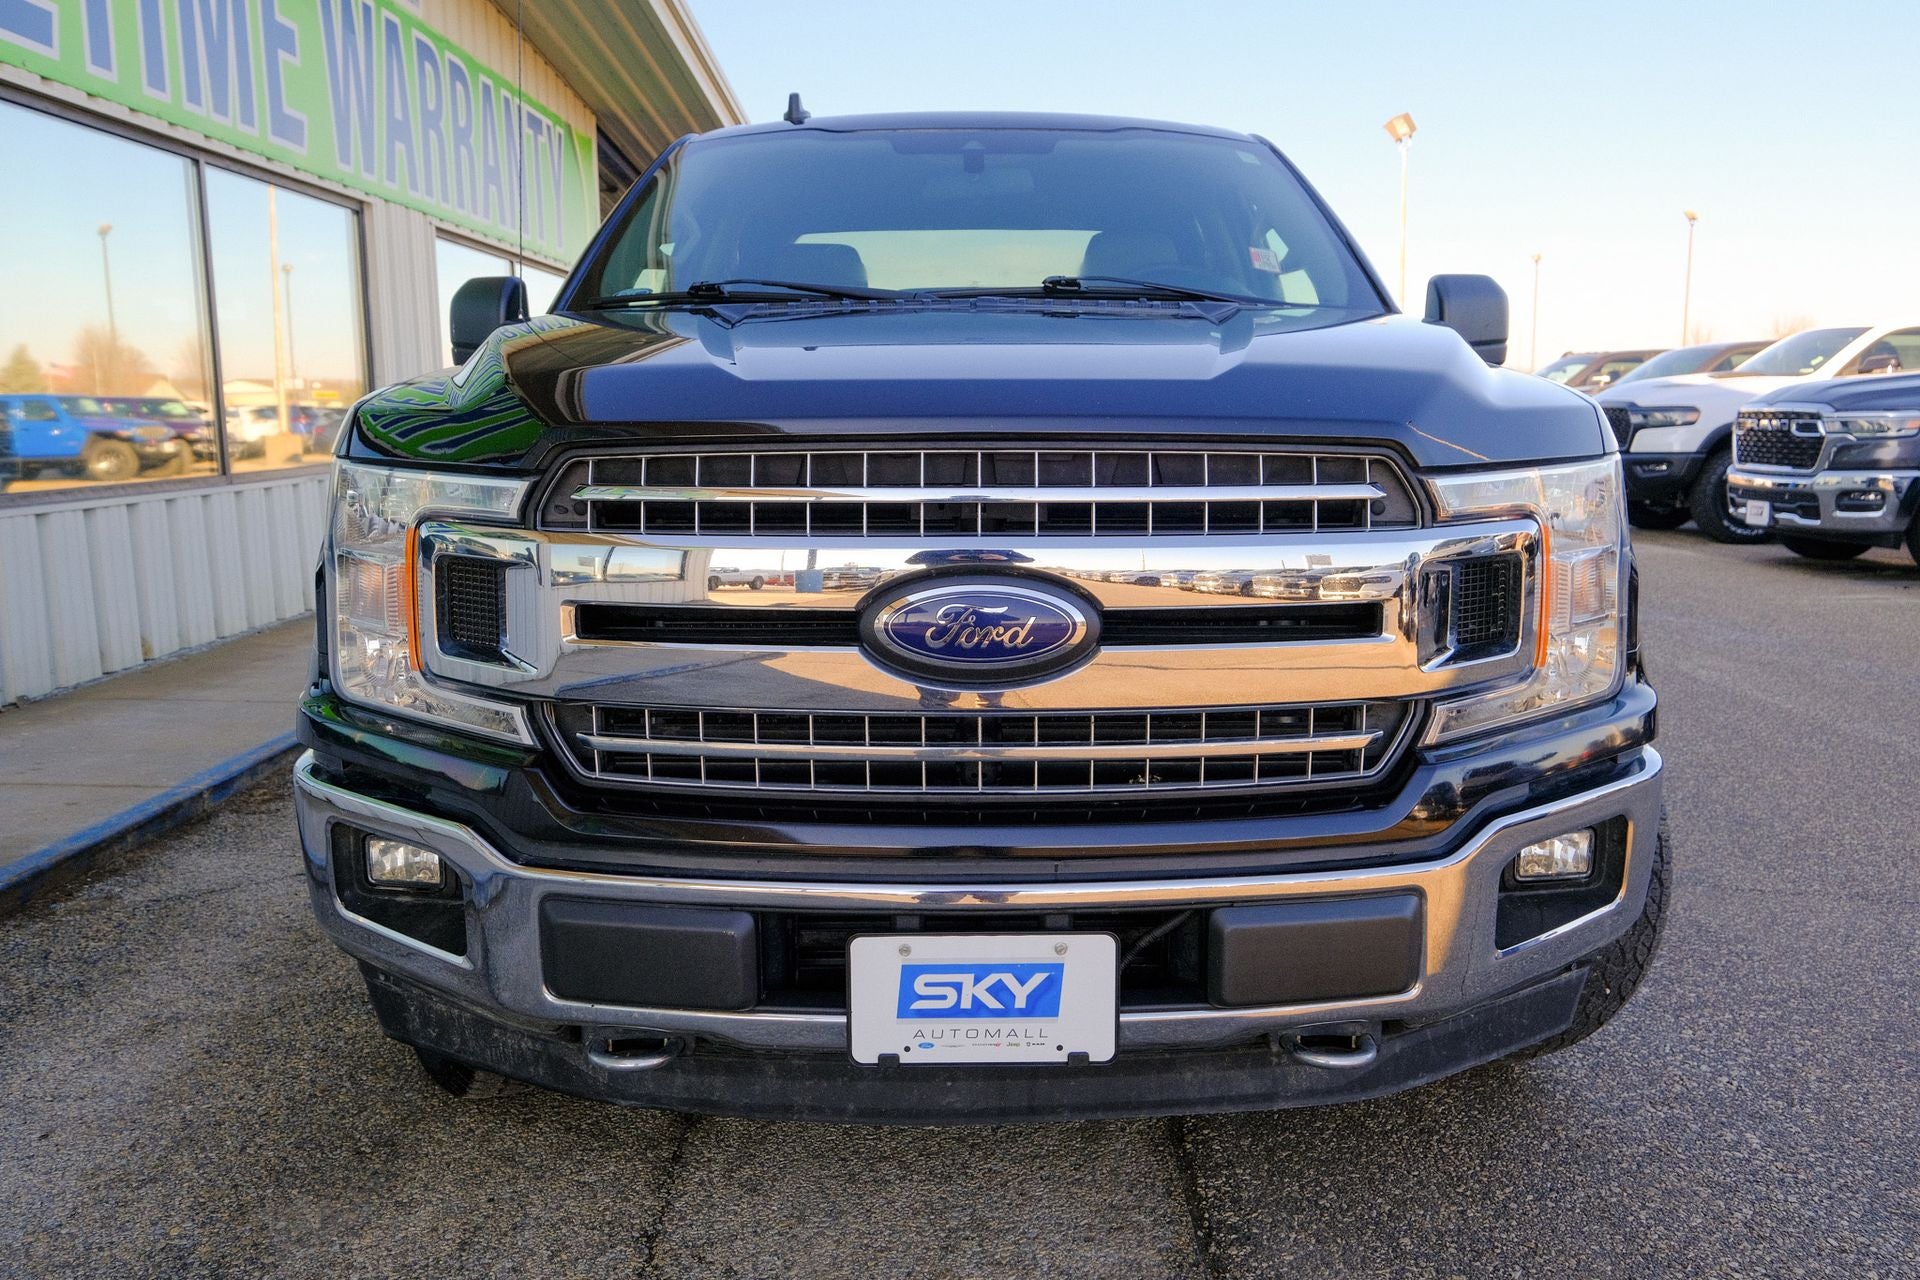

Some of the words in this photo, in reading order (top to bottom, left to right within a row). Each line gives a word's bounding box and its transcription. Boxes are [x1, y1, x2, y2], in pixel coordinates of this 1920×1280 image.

[316, 0, 564, 249] WARRANTY
[924, 603, 1037, 649] Ford
[908, 972, 1051, 1010] SKY
[912, 1028, 1049, 1040] AUTOMALL
